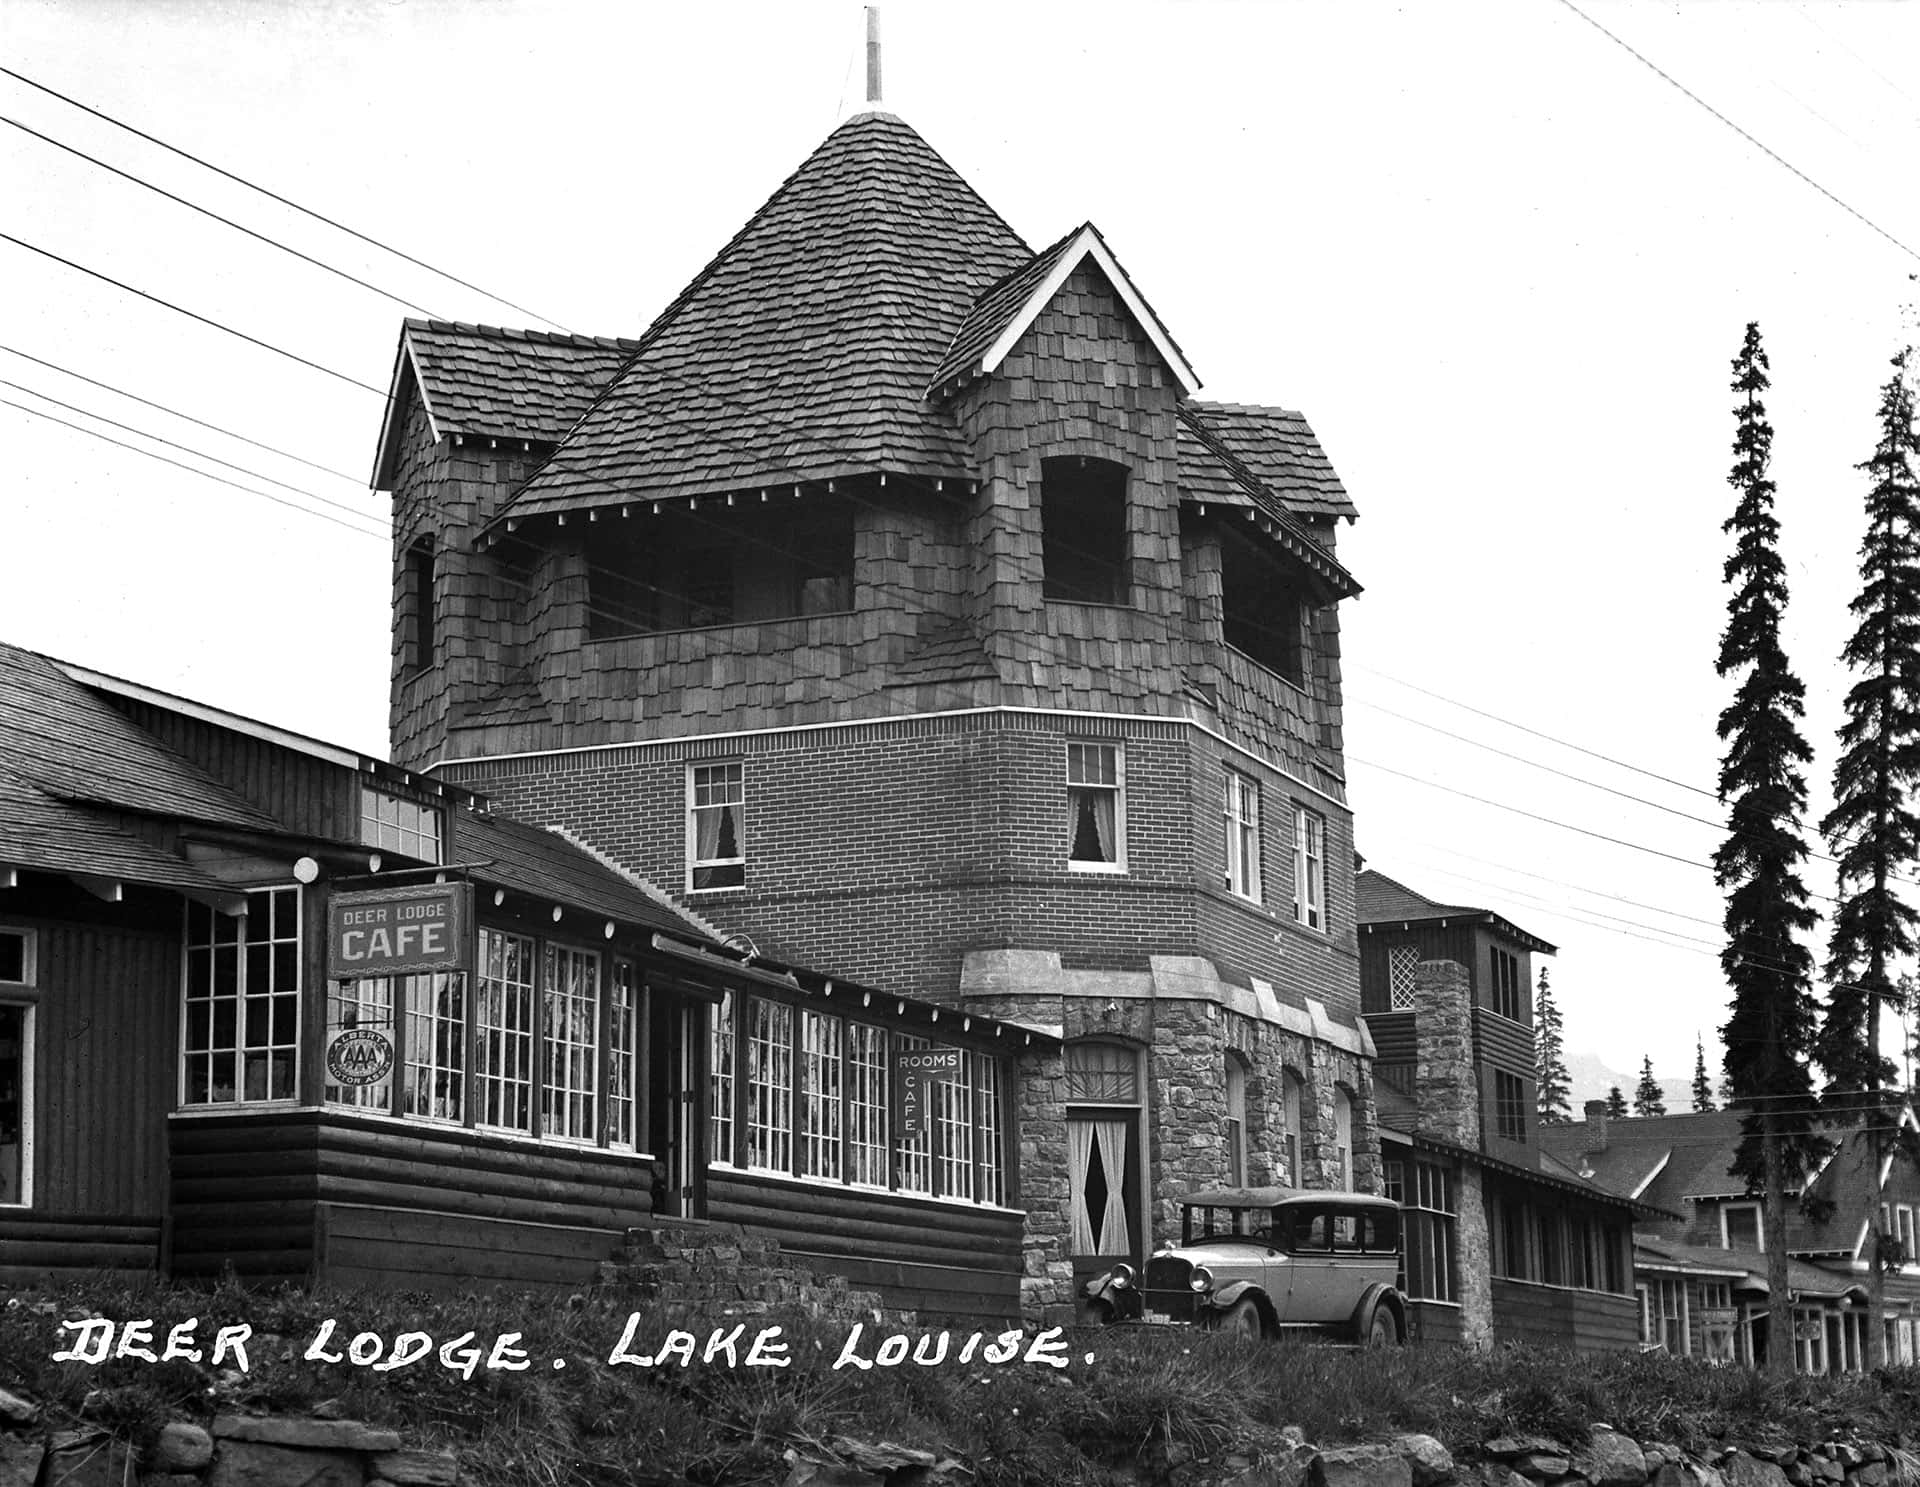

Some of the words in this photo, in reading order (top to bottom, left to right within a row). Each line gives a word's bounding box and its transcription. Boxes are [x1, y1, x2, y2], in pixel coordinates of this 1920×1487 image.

[343, 908, 387, 926] DEER
[396, 903, 446, 920] LODGE
[342, 922, 446, 960] CAFE
[334, 1031, 388, 1050] ALBERTA
[343, 1044, 378, 1070] AAA
[899, 1054, 957, 1068] ROOMS
[329, 1063, 361, 1084] MOTOR
[904, 1076, 916, 1131] CAFE
